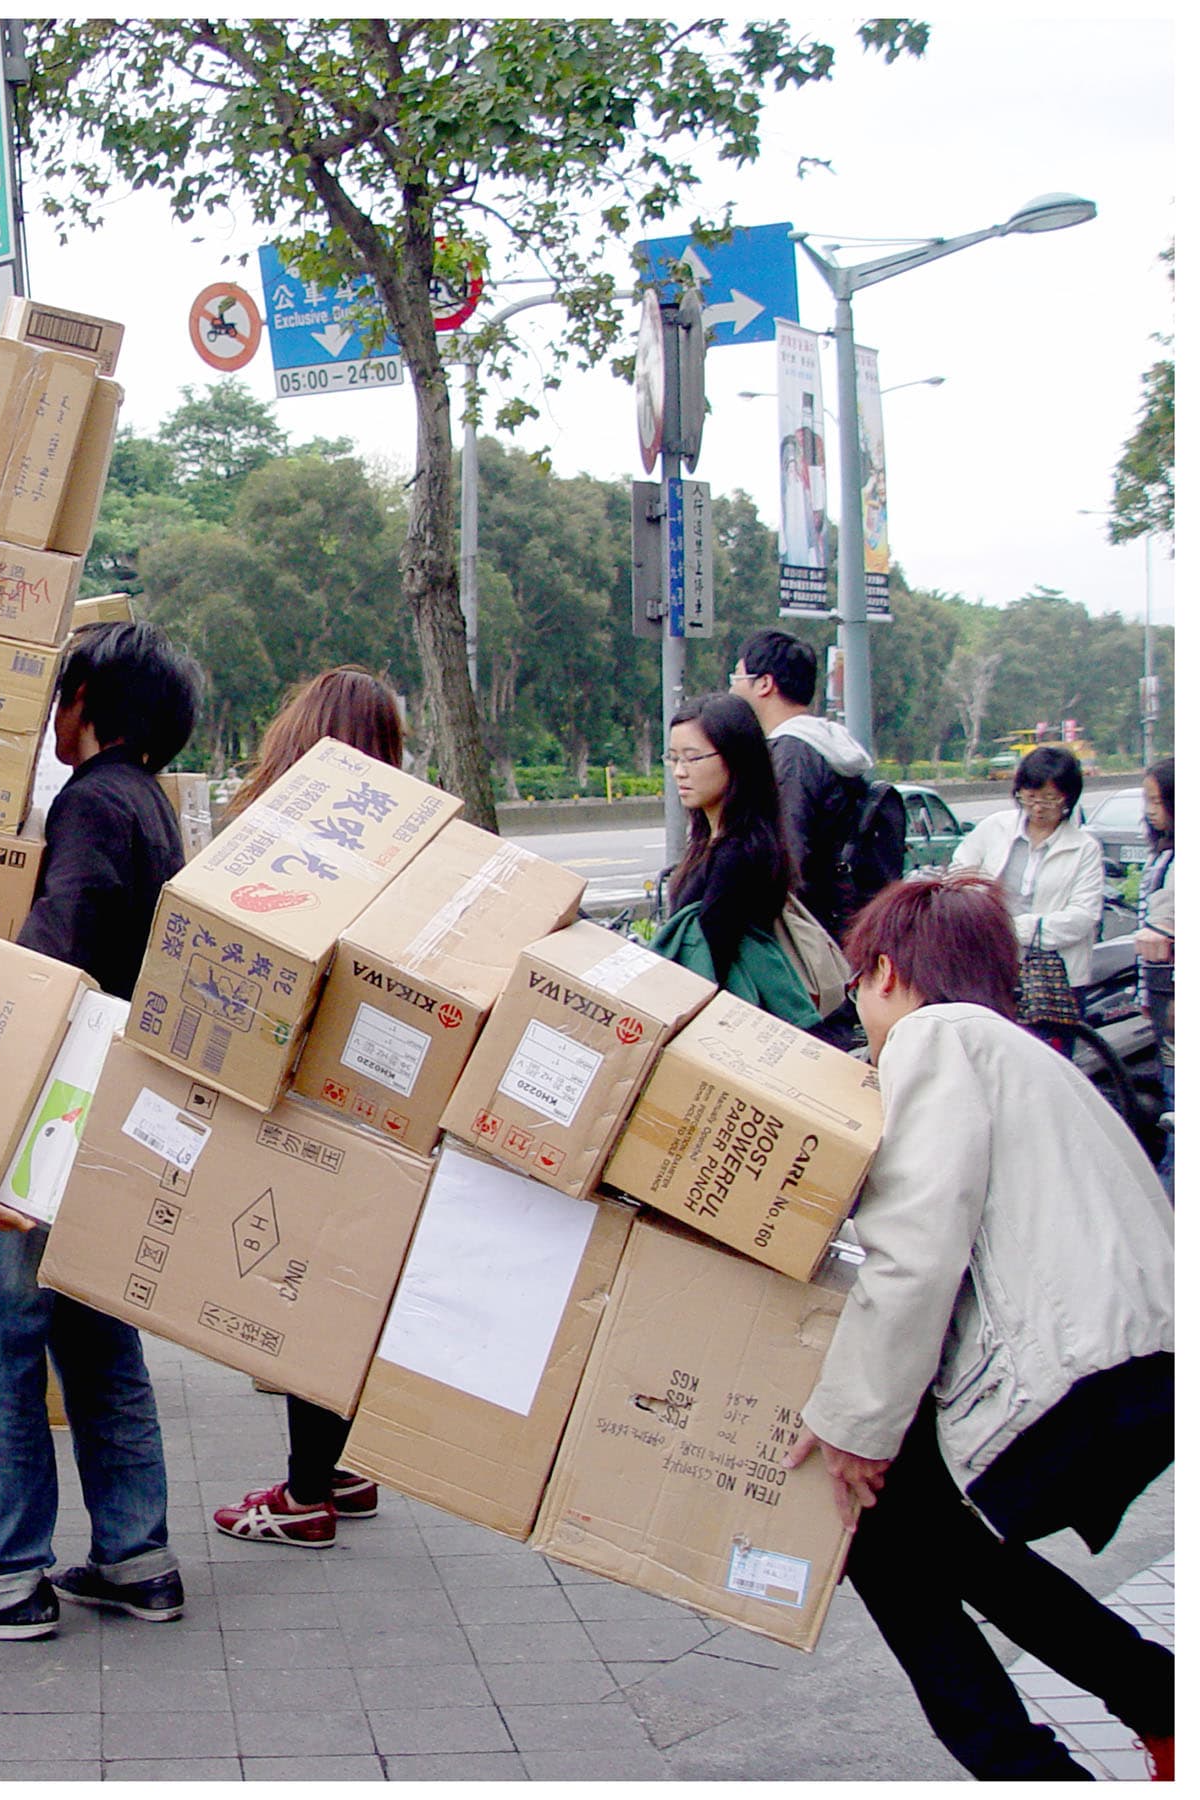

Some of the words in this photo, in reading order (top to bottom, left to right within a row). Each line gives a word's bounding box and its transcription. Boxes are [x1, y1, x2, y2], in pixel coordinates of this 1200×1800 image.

[273, 306, 328, 329] Exclusive
[392, 794, 443, 843] 世界性食品
[352, 960, 438, 1014] KIKAWA
[529, 969, 618, 1030] KIKAWA
[355, 1054, 397, 1078] KH0220
[515, 1078, 558, 1106] KH0220
[706, 1090, 728, 1125] Manually
[677, 1103, 706, 1152] PERFORATION
[682, 1103, 697, 1122] HOLE
[712, 1098, 747, 1152] PAPER
[676, 1124, 686, 1136] TO
[666, 1137, 681, 1156] HOLE
[699, 1105, 765, 1219] POWERFUL
[753, 1115, 784, 1182] MOST
[649, 1158, 670, 1192] DISTANCE
[660, 1152, 682, 1189] DIAMETER
[780, 1134, 819, 1193] CARL
[684, 1156, 719, 1213] PUNCH
[754, 1195, 790, 1248] No.160
[277, 1258, 310, 1302] C/NO.
[668, 1368, 700, 1391] KGS
[662, 1387, 695, 1410] KGS
[658, 1403, 690, 1430] PCS
[767, 1422, 800, 1444] N.W:
[752, 1440, 791, 1467] TY:
[710, 1469, 737, 1492] NO.
[740, 1458, 788, 1486] CODE:
[742, 1480, 782, 1506] ITEM
